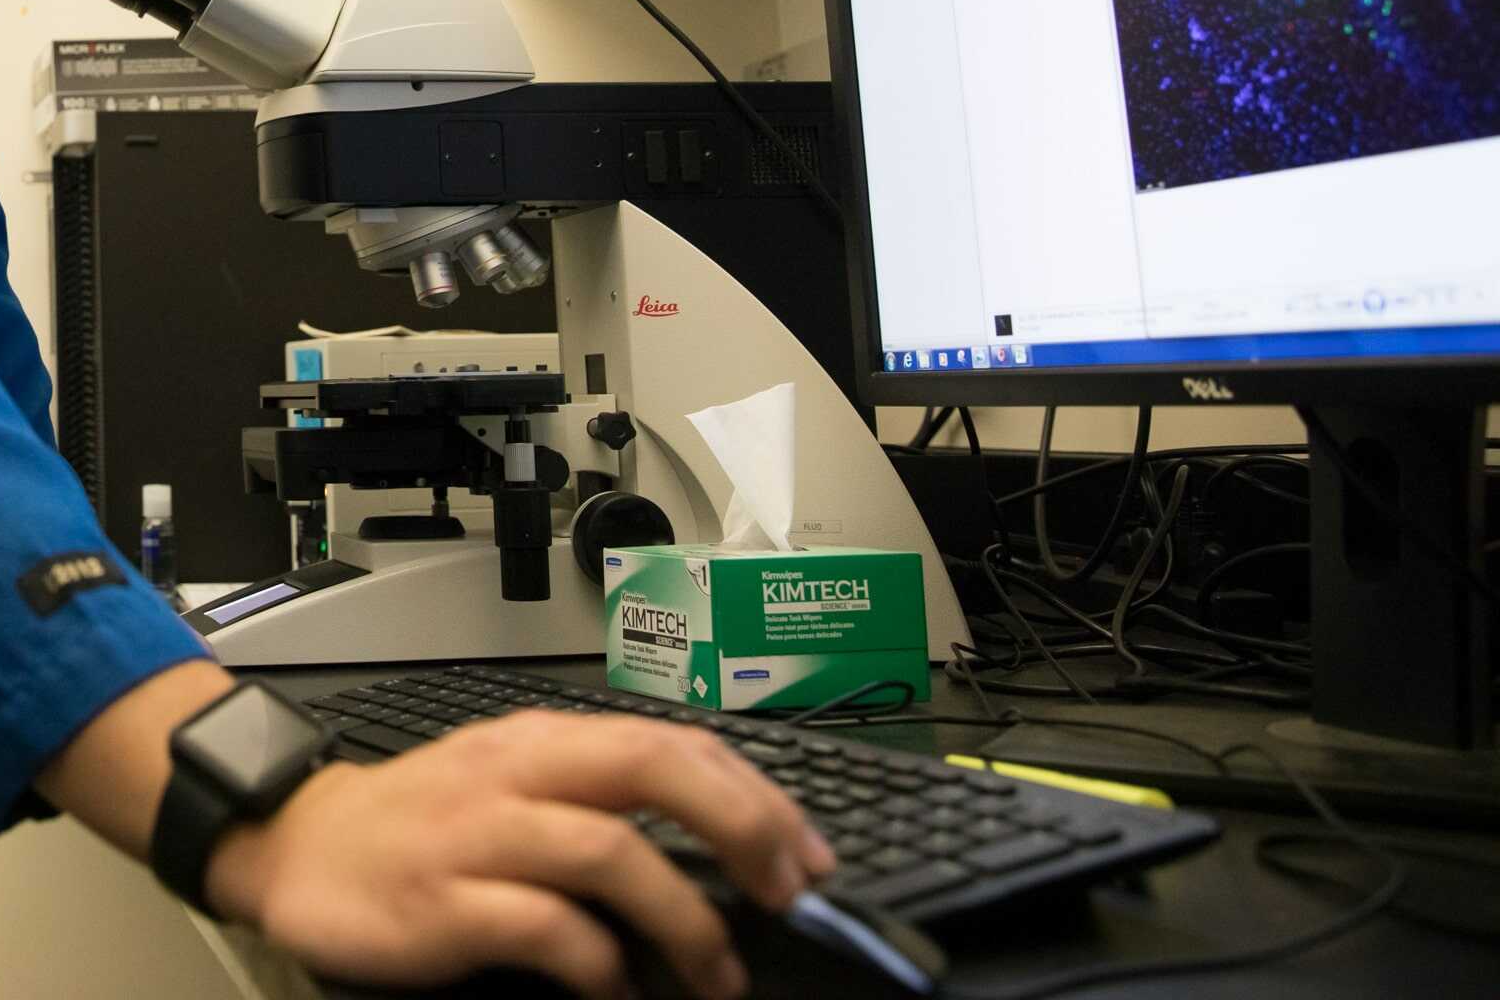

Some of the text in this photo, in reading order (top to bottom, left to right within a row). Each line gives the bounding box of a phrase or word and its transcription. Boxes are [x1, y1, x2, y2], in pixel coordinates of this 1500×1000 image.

[632, 295, 680, 317] Leica
[1182, 377, 1234, 399] DELL
[761, 570, 804, 581] Kimwipes
[762, 579, 869, 602] KIMTECH
[622, 605, 687, 637] KIMTECH
